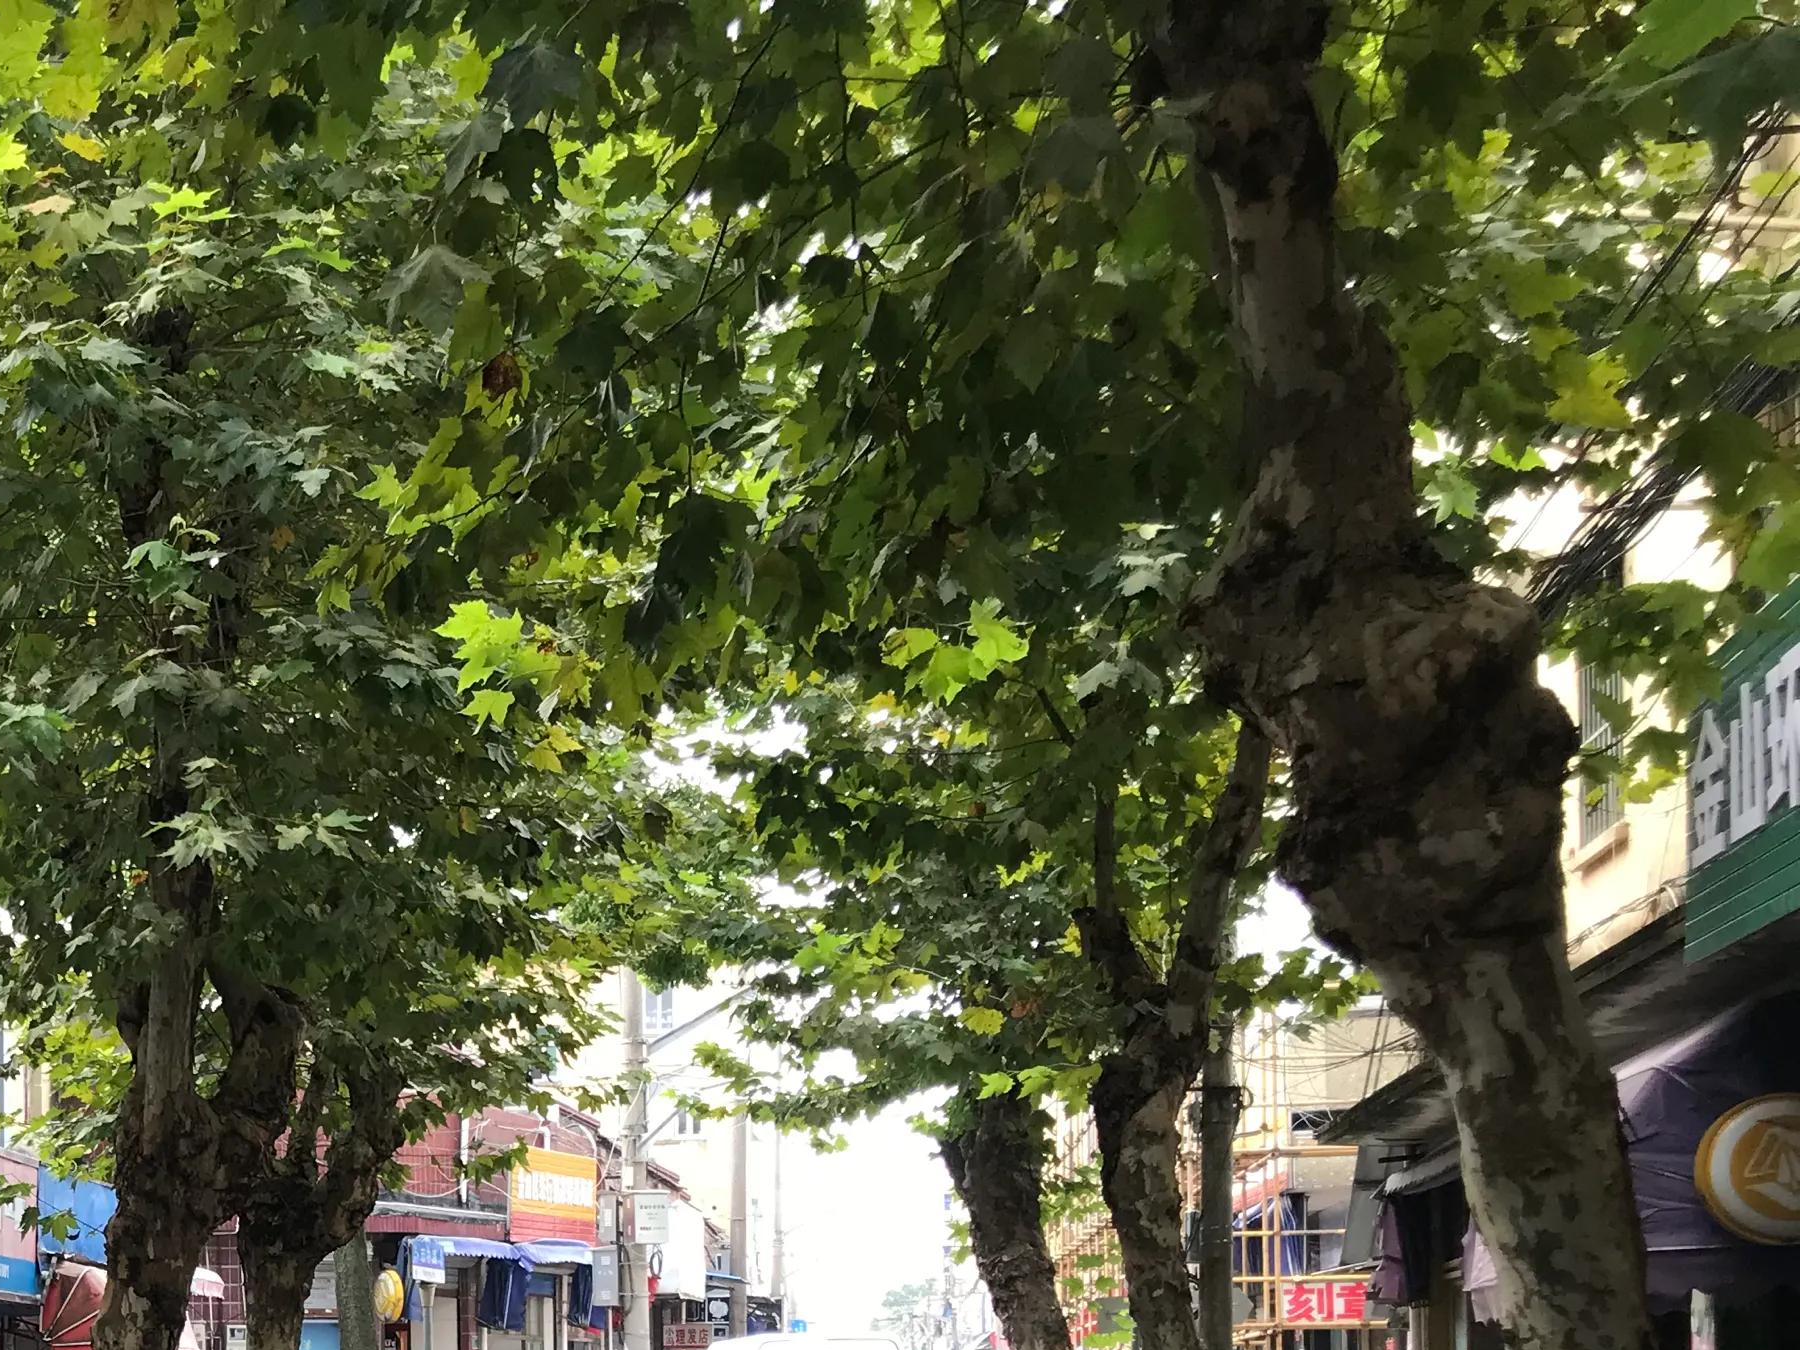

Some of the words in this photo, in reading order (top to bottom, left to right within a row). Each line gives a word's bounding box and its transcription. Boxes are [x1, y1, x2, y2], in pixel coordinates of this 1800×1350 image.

[1283, 1281, 1368, 1322] 刻章
[675, 1328, 709, 1345] 理发店
